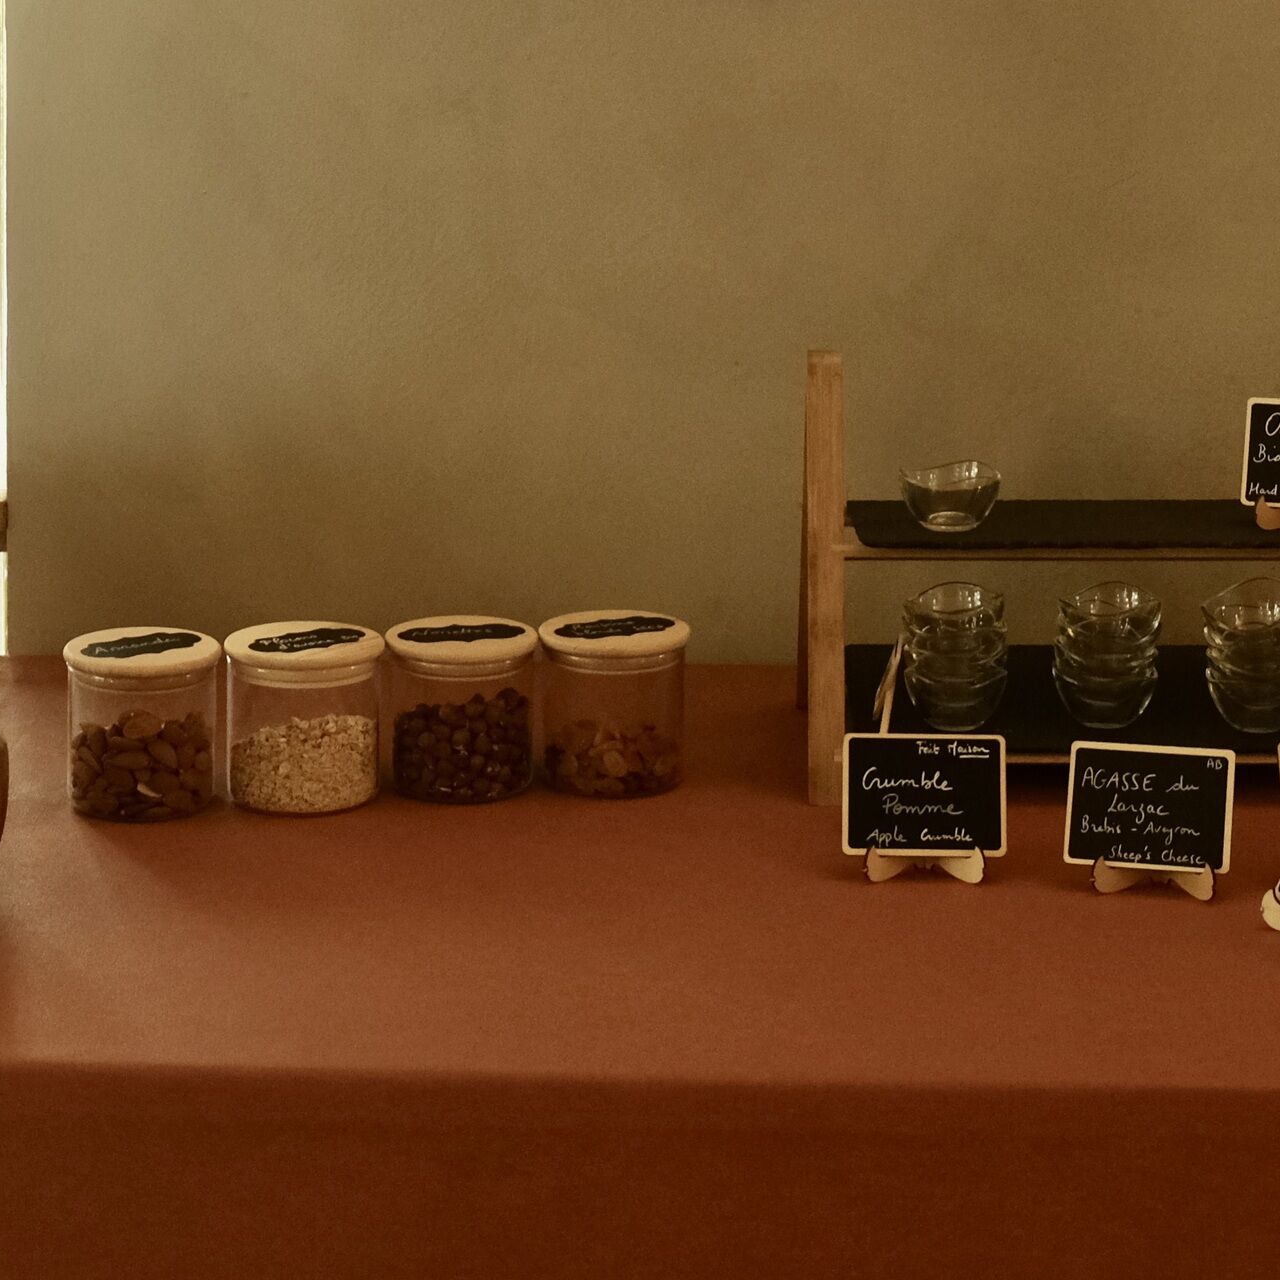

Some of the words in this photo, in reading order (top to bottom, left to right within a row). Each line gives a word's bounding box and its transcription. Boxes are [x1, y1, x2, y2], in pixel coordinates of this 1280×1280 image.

[1248, 481, 1278, 496] Hard
[1206, 758, 1223, 770] AB
[862, 767, 954, 791] Crumble
[1081, 766, 1157, 793] AGASSE
[1166, 774, 1200, 793] du
[882, 793, 964, 815] Pomme
[1107, 793, 1170, 824] Larzac
[1080, 814, 1122, 834] Brebis
[866, 825, 907, 848] Apple
[920, 827, 973, 842] Crumble
